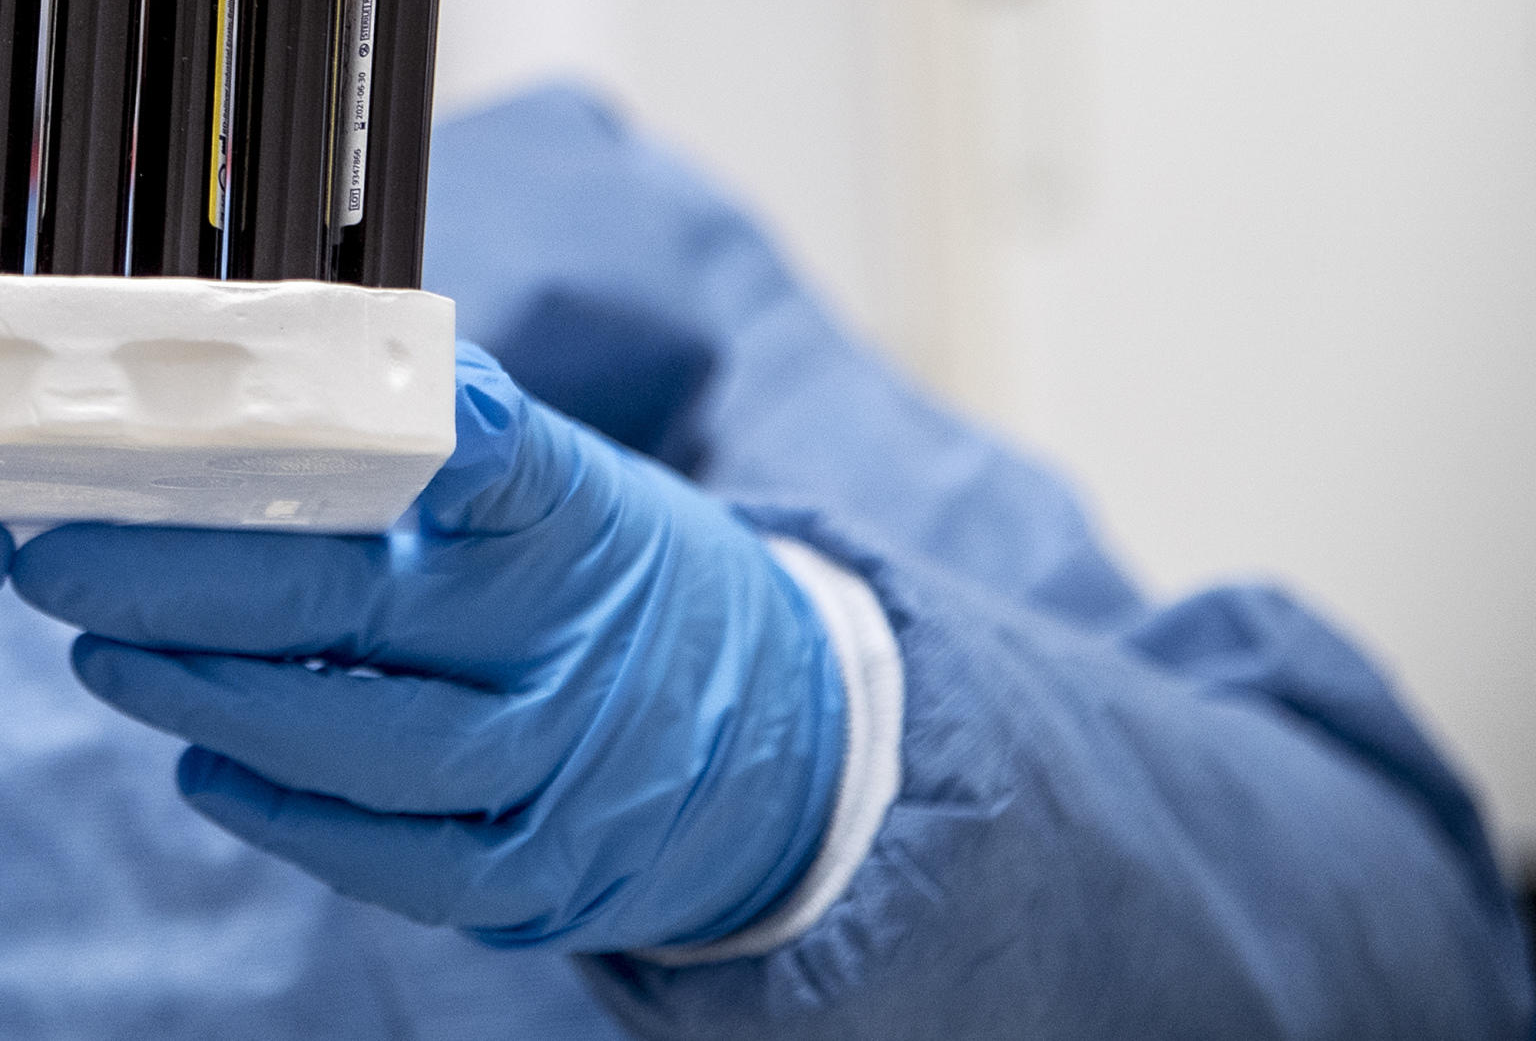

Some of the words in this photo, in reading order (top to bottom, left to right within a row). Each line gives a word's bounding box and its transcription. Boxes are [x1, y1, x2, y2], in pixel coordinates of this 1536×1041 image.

[356, 72, 366, 119] 2021-06-30
[352, 149, 362, 185] 9347866
[350, 190, 360, 209] LOT
